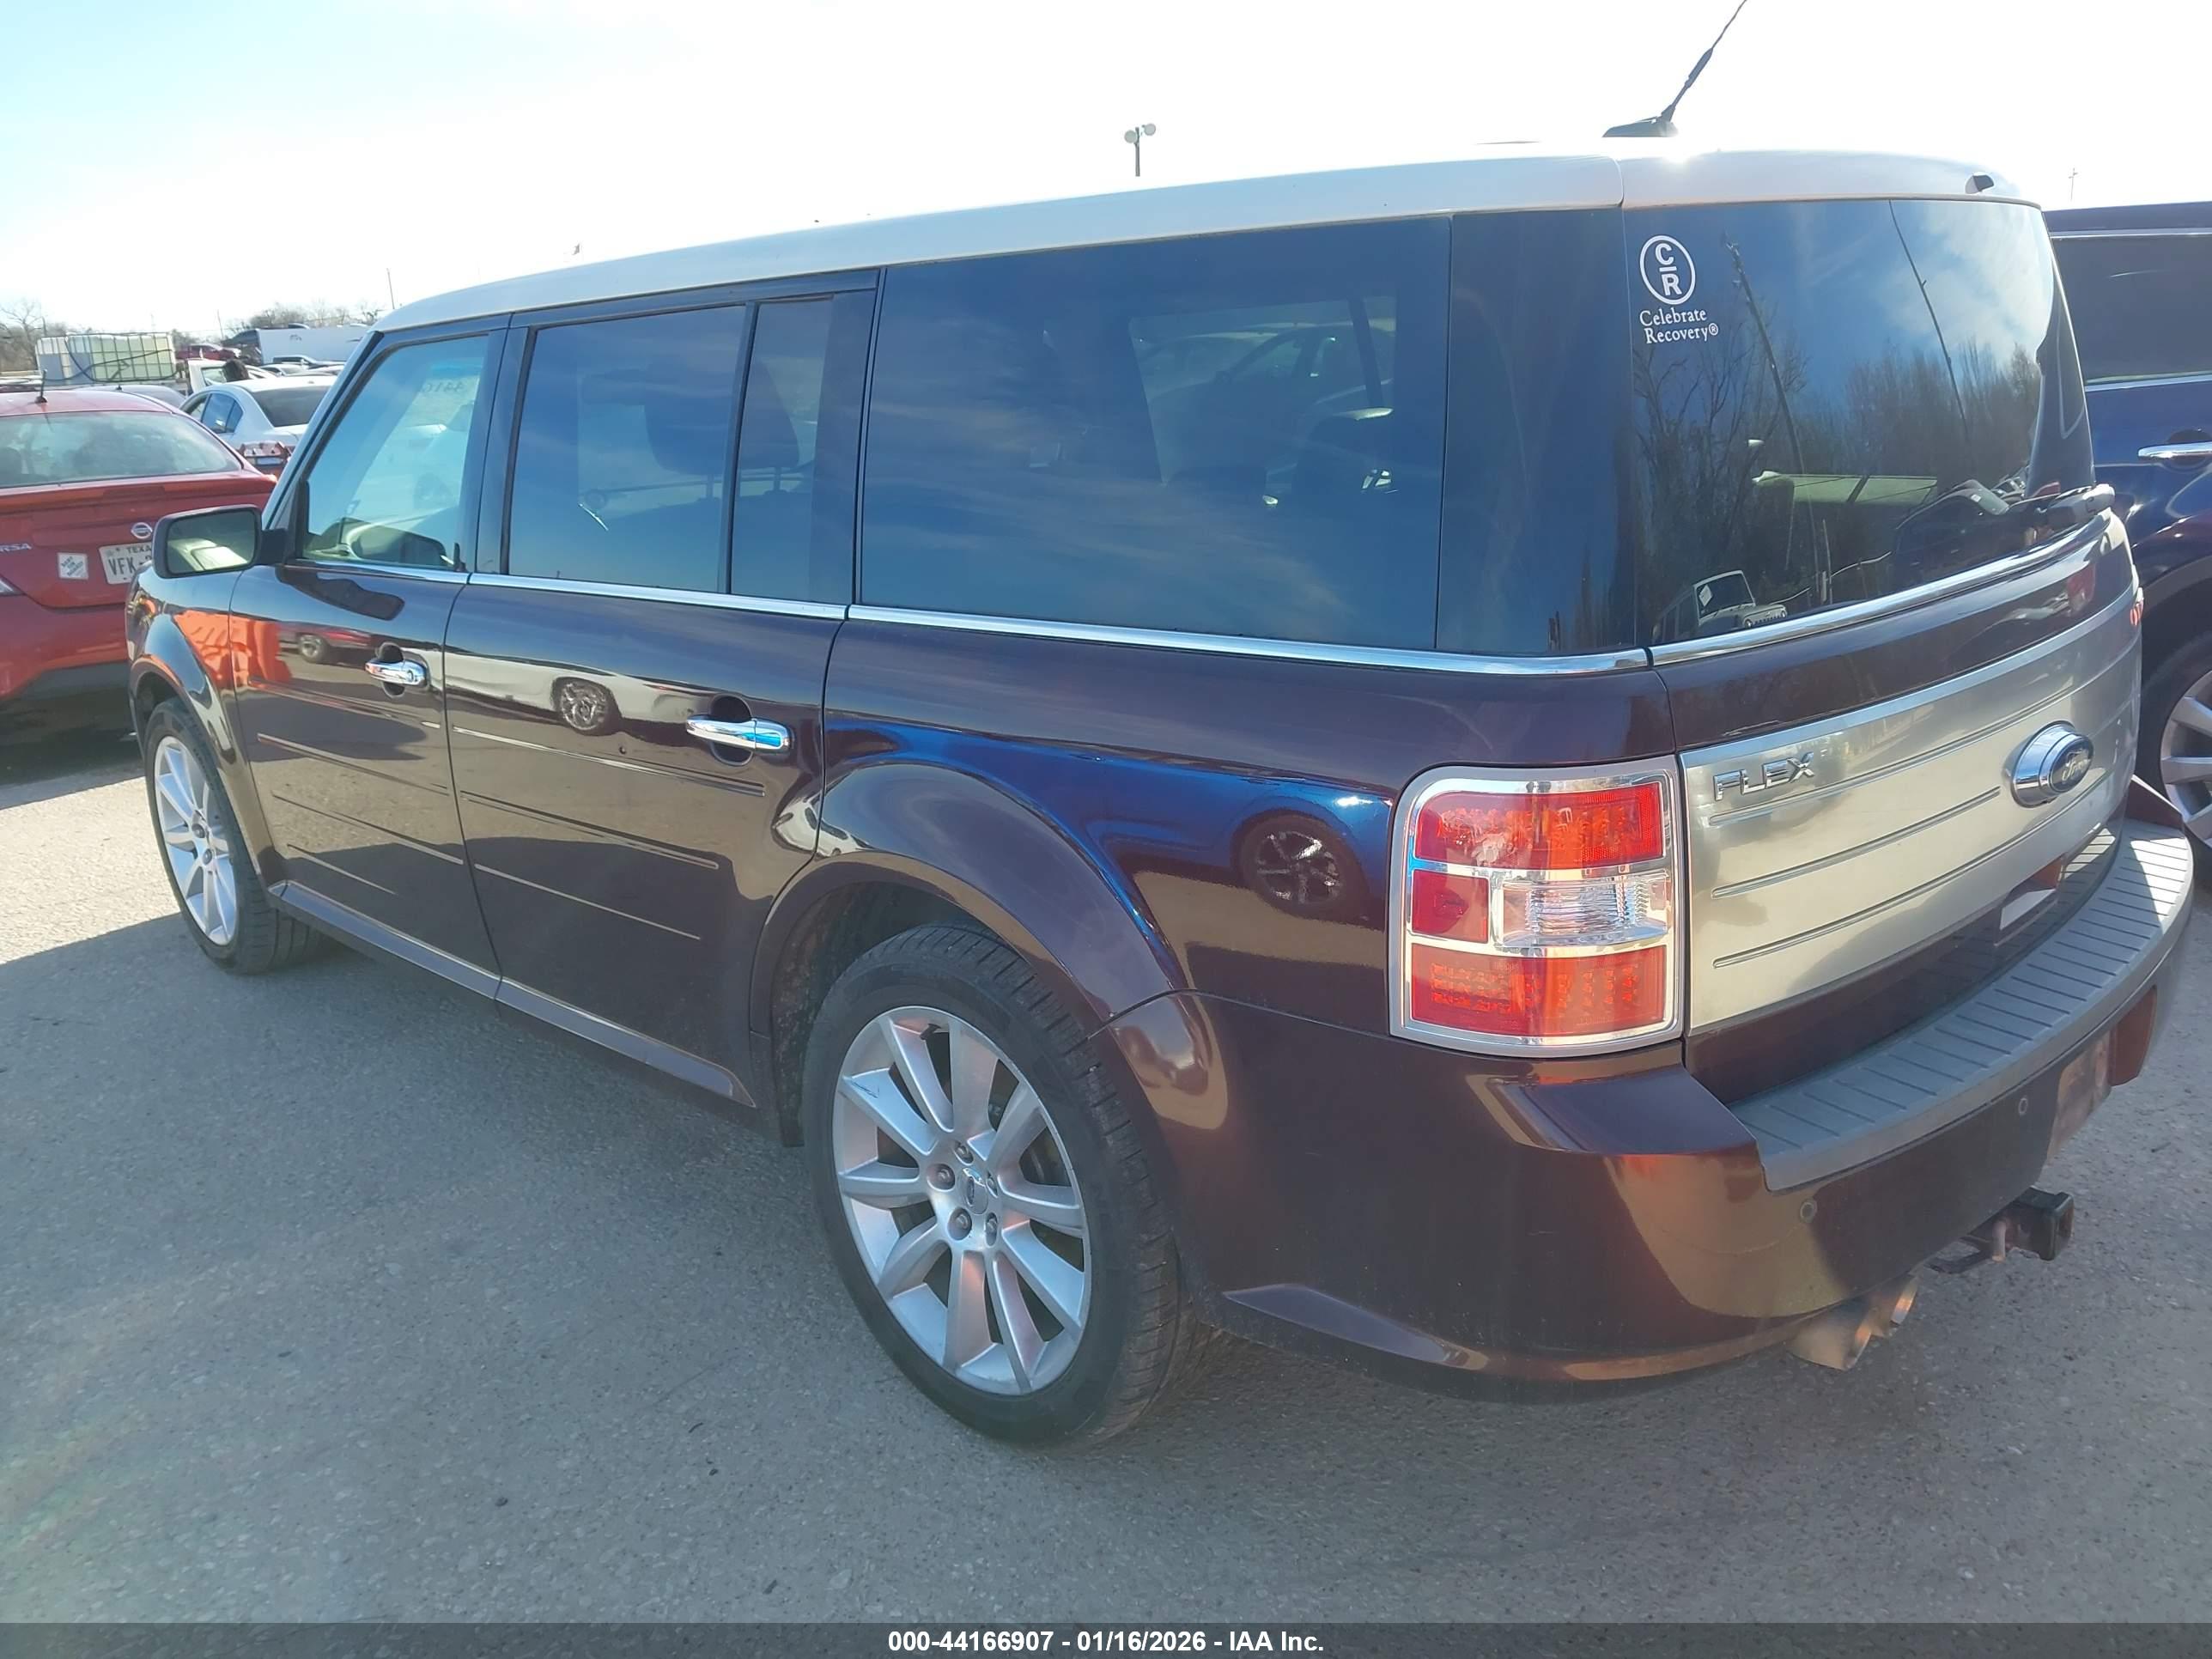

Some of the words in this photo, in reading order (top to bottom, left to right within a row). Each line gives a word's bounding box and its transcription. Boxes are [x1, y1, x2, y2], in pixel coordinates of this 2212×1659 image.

[1655, 242, 1674, 265] C
[1661, 273, 1682, 296] R
[1638, 307, 1708, 327] Celebrate
[126, 544, 152, 554] TEXA
[1712, 751, 1814, 801] FLEX
